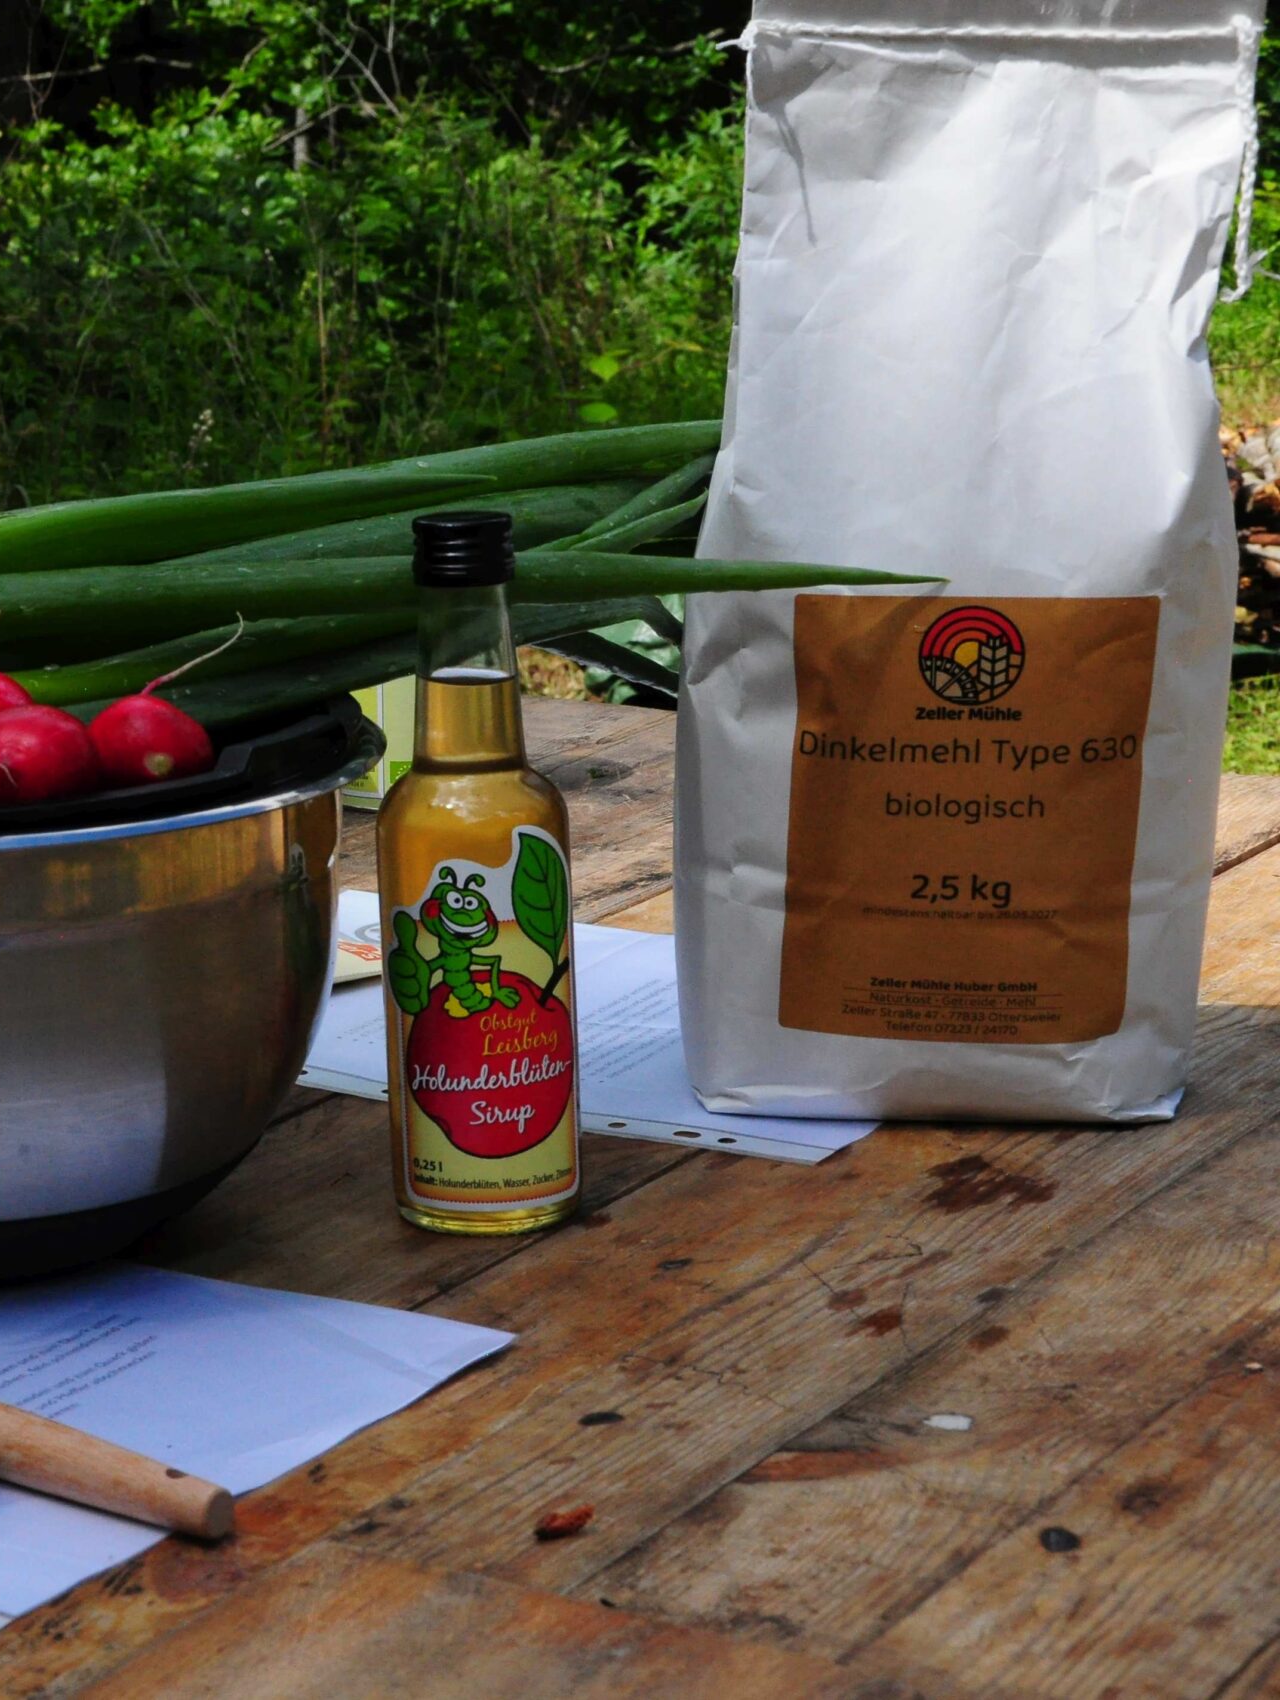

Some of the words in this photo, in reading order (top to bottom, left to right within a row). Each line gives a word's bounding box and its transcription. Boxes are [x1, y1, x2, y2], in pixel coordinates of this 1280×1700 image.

[915, 707, 964, 721] Zeller
[968, 706, 1022, 722] Mühle
[799, 730, 980, 764] Dinkelmehl
[991, 737, 1071, 770] Type
[1081, 734, 1137, 763] 630
[885, 793, 1045, 824] biologisch
[910, 875, 959, 903] 2,5
[971, 875, 1011, 907] kg
[870, 977, 907, 989] Zeller
[911, 979, 950, 991] Mühle
[954, 981, 993, 992] Huber
[998, 982, 1038, 992] GmbH
[870, 992, 931, 1005] Naturkost
[941, 996, 995, 1007] Getreide
[1006, 997, 1037, 1007] Mehl
[480, 1008, 537, 1032] Obstgut
[842, 1005, 876, 1016] Zeller
[880, 1008, 921, 1020] Straße
[988, 1013, 1061, 1022] Ottersweier
[886, 1021, 930, 1033] Telefon
[482, 1026, 558, 1057] Leisberg
[469, 1101, 536, 1134] Sirup
[413, 1157, 436, 1172] 0,25
[439, 1177, 502, 1189] Holunderblüten,
[503, 1177, 531, 1189] Wasser,
